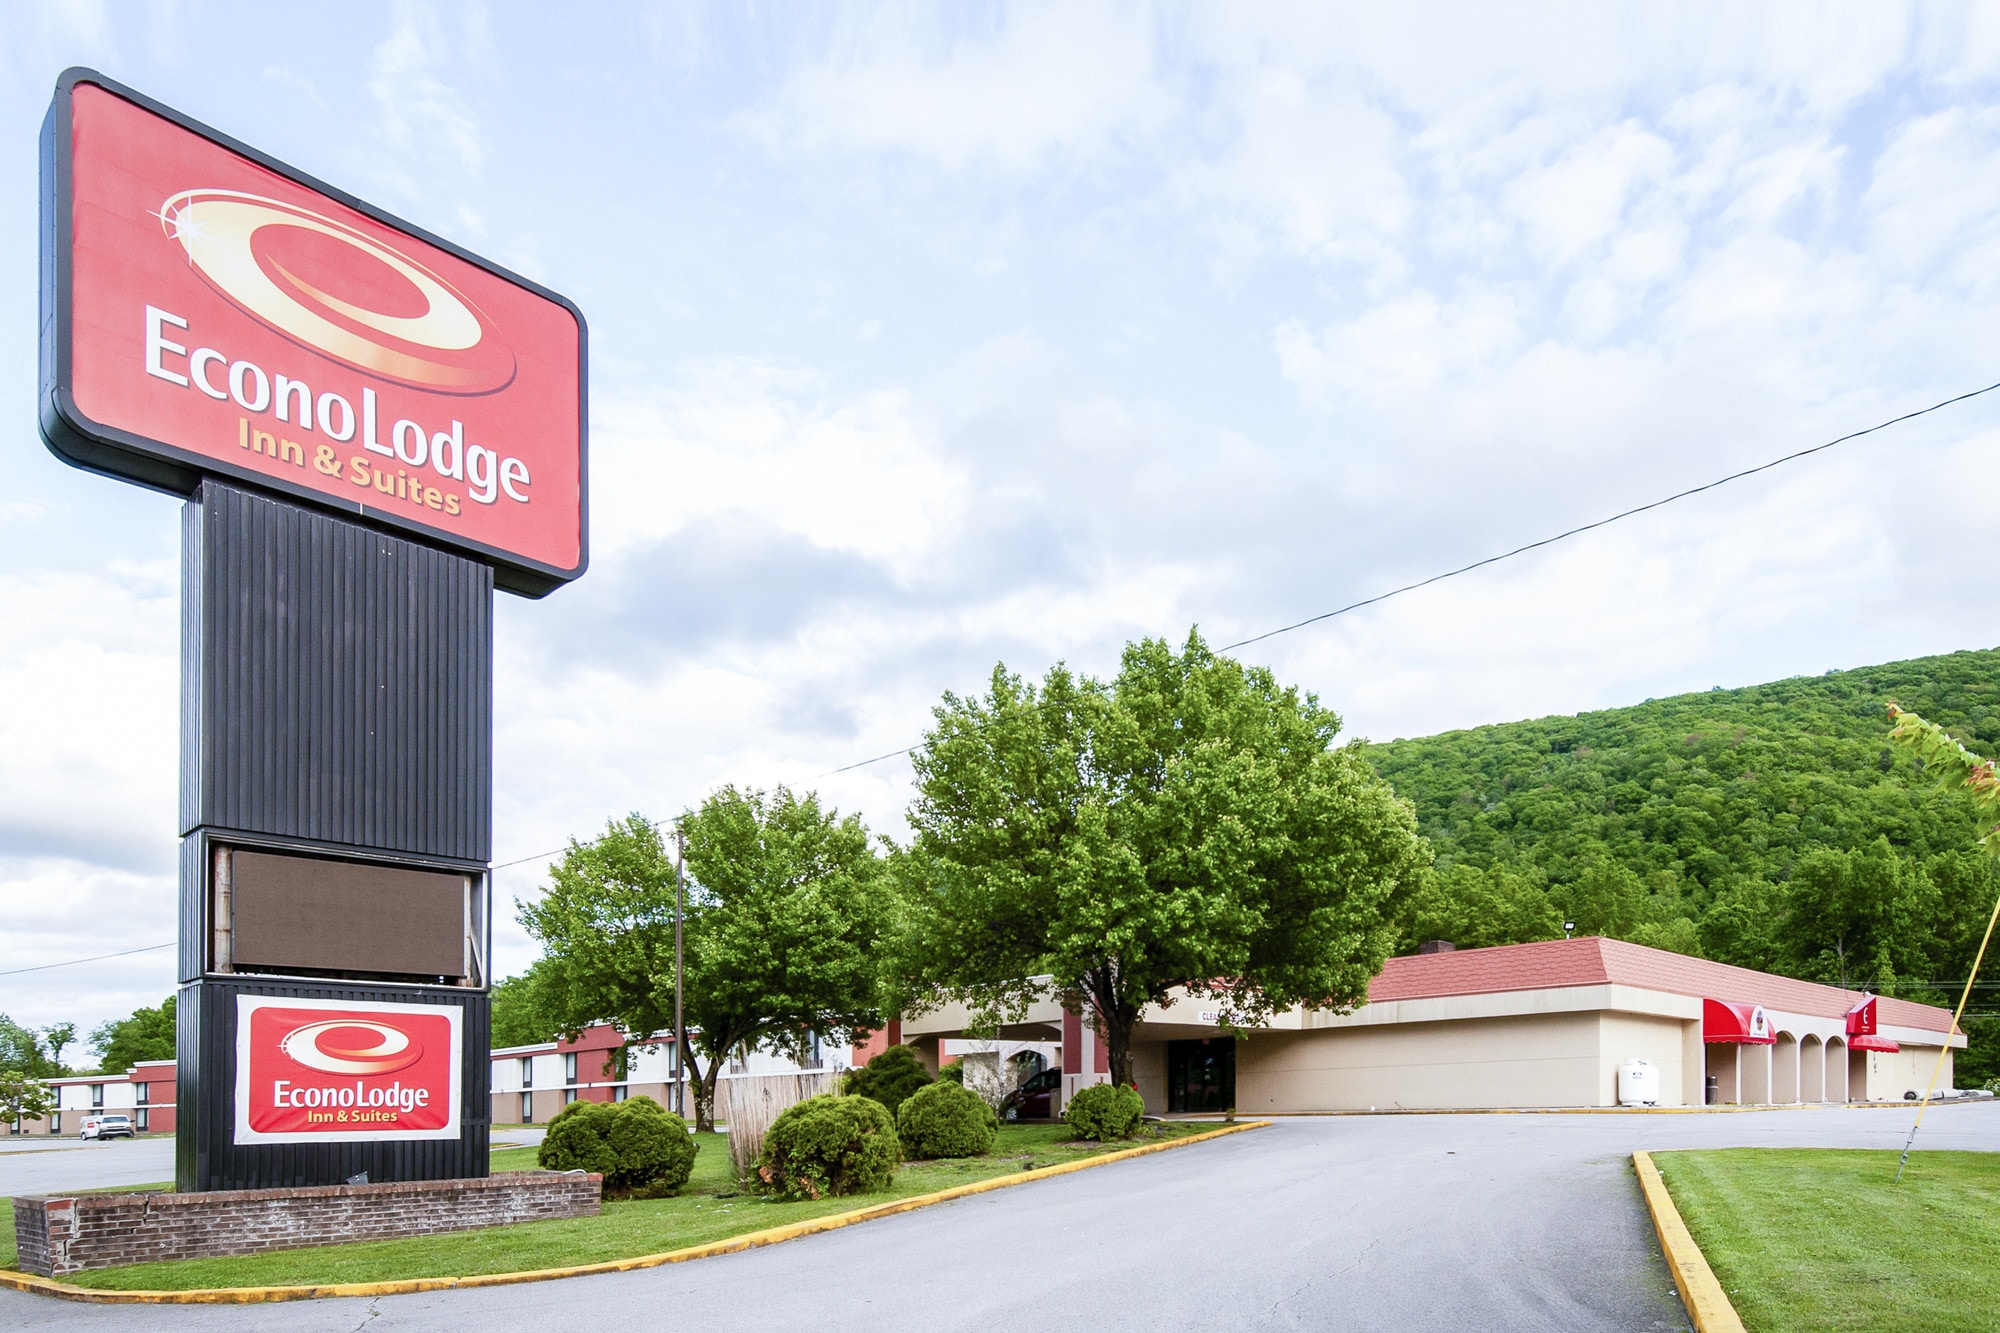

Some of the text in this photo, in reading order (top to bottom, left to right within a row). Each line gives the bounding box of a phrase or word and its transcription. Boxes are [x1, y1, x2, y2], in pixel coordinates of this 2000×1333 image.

[144, 304, 531, 504] EconoLodge
[238, 416, 461, 516] Inn & Suites
[274, 1080, 429, 1113] EconoLodge
[307, 1110, 398, 1123] Inn & Suites
